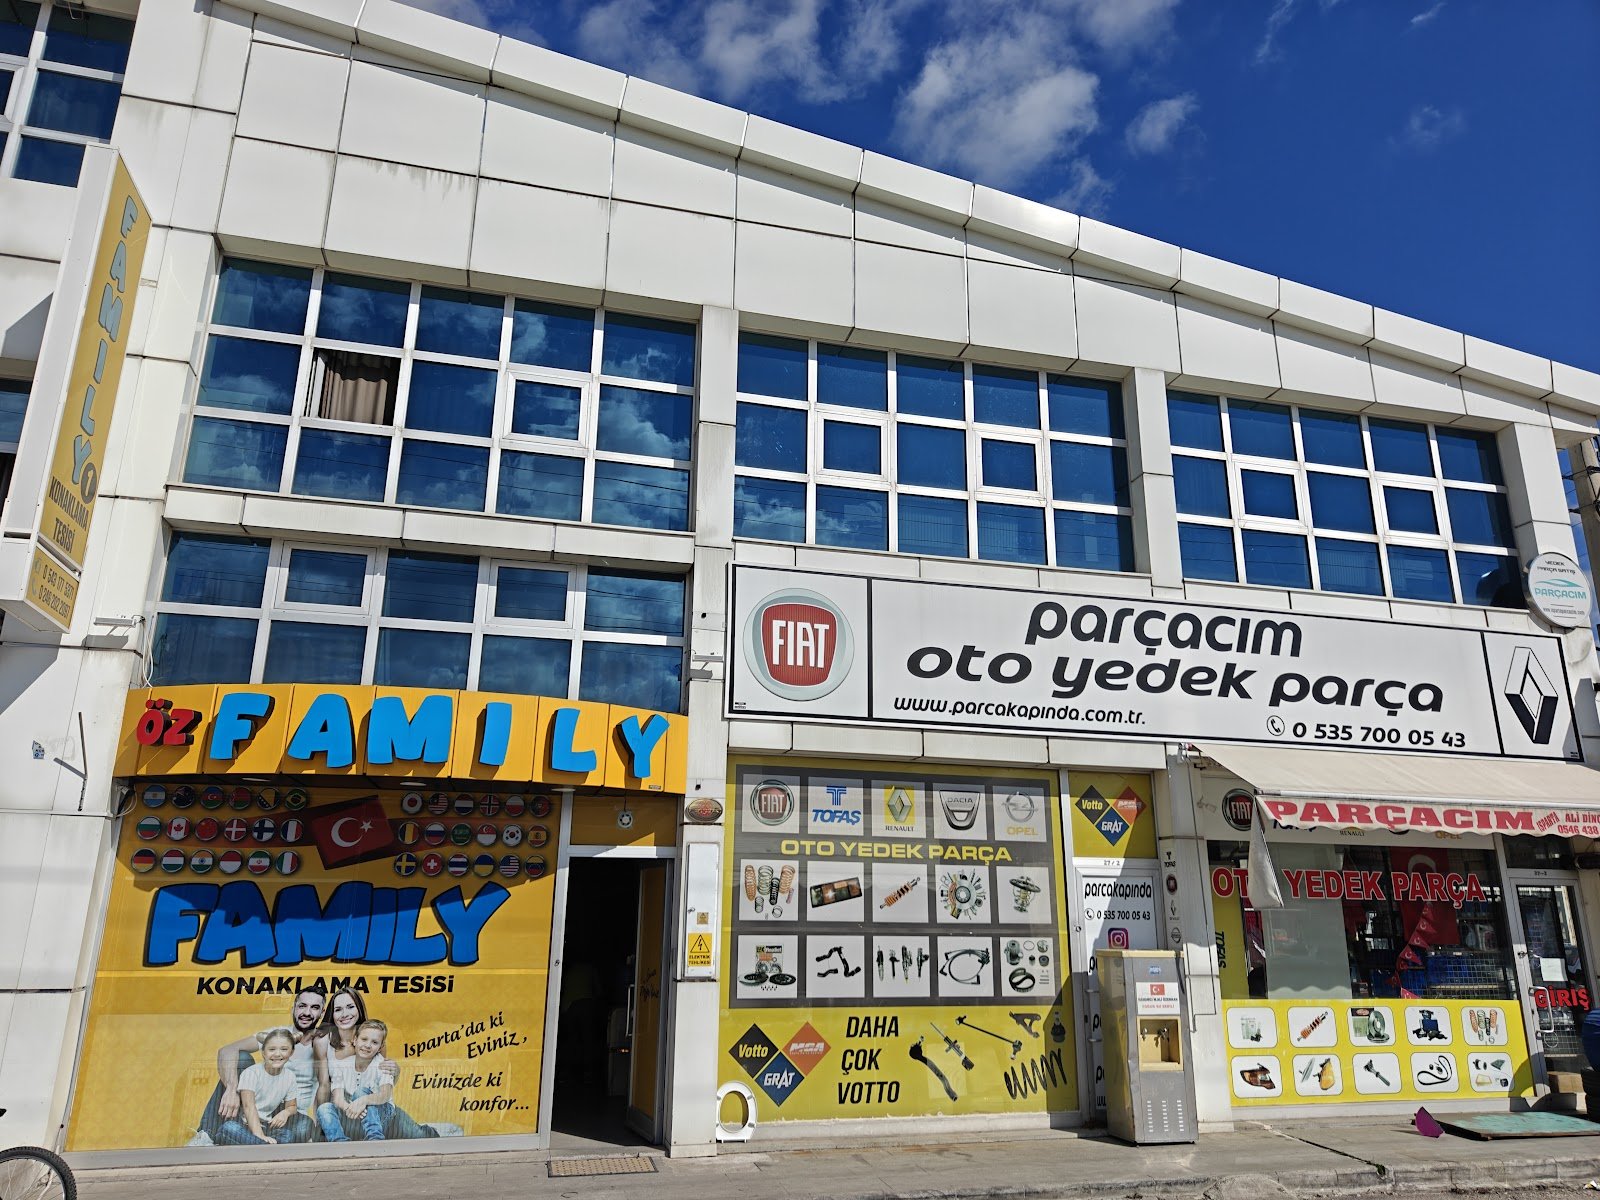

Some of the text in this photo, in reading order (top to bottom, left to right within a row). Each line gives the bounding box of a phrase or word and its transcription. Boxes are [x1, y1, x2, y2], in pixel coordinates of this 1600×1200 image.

[71, 194, 139, 486] FAMILY
[48, 475, 90, 532] KONAKLAMA
[52, 516, 76, 554] TESİSİ
[42, 564, 49, 580] 0
[1534, 587, 1587, 600] PARÇACIM
[1025, 601, 1302, 658] parçacım
[771, 619, 830, 669] FIAT
[906, 645, 1444, 717] oto yedek parça
[136, 692, 669, 779] ÖZ FAMILY
[1292, 722, 1466, 748] 0 535 700 05 43
[760, 792, 785, 812] FIAT
[1081, 799, 1103, 810] Votto
[1230, 801, 1252, 820] FIAT
[811, 808, 861, 826] TOFAŞ
[1101, 819, 1123, 833] GRAT
[1263, 800, 1534, 831] PARÇACIM
[1565, 811, 1580, 823] ALİ
[1007, 826, 1039, 836] OPEL
[1557, 825, 1599, 835] 0546 438
[780, 840, 1013, 866] OTO YEDEK PARÇA
[1212, 866, 1487, 909] OT YEDEK PARÇA
[142, 880, 511, 969] FAMILY
[1096, 910, 1151, 921] 0 535 700 05 43
[196, 974, 455, 995] KONAKLAMA TESİSİ
[1533, 985, 1591, 1011] GİRİŞ
[403, 1011, 505, 1058] Isparta'da ki
[846, 1016, 899, 1038] DAHA
[738, 1044, 769, 1058] Votto
[841, 1048, 882, 1076] ÇOK
[411, 1071, 504, 1091] Evinizde ki
[763, 1067, 796, 1089] GRAT
[837, 1080, 901, 1105] VOTTO
[459, 1095, 529, 1113] konfor...
